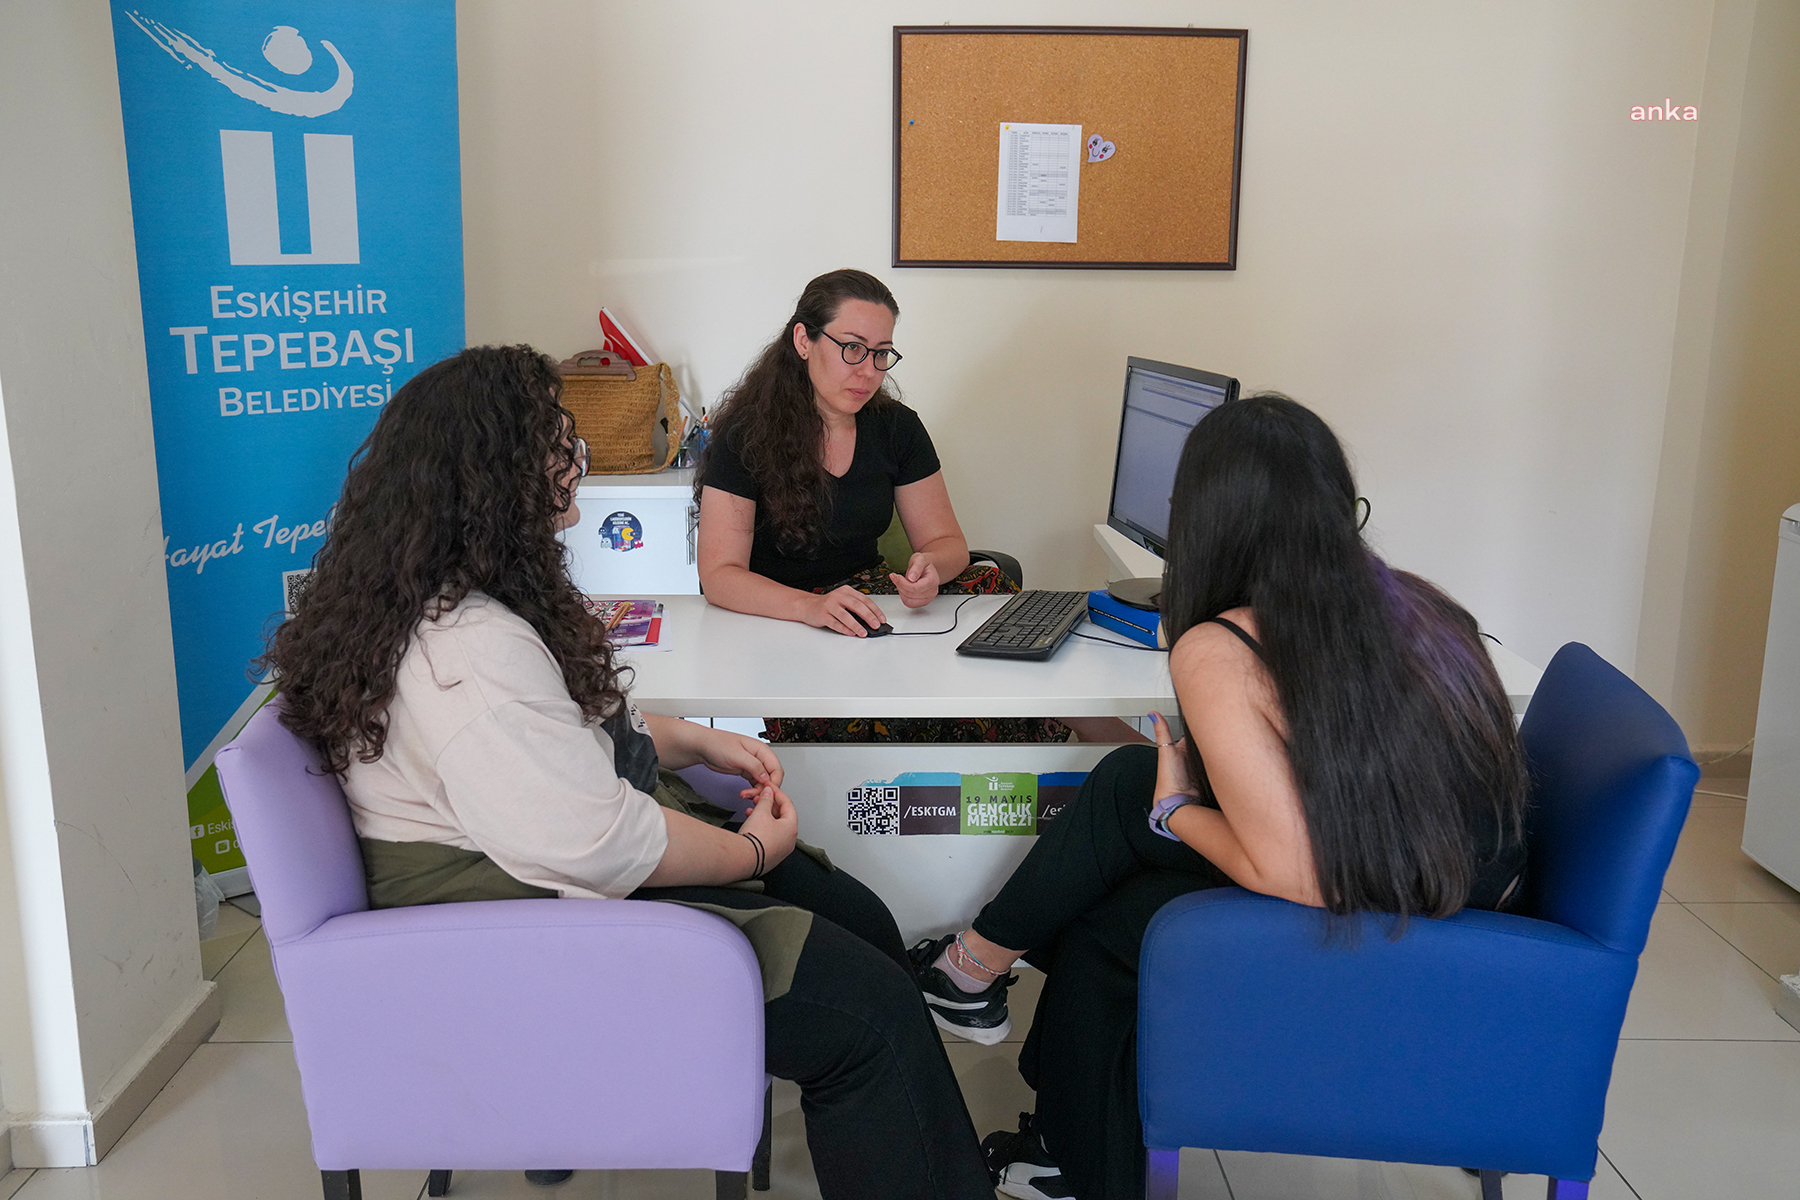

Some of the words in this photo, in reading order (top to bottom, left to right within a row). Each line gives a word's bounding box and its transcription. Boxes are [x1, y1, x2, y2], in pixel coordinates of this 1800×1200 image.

[169, 326, 414, 374] TEPEBAŞI
[164, 522, 244, 574] ayat
[253, 503, 337, 553] Tepe
[904, 805, 956, 818] /ESKTGM
[966, 796, 980, 804] 19
[989, 795, 1032, 803] MAYIS
